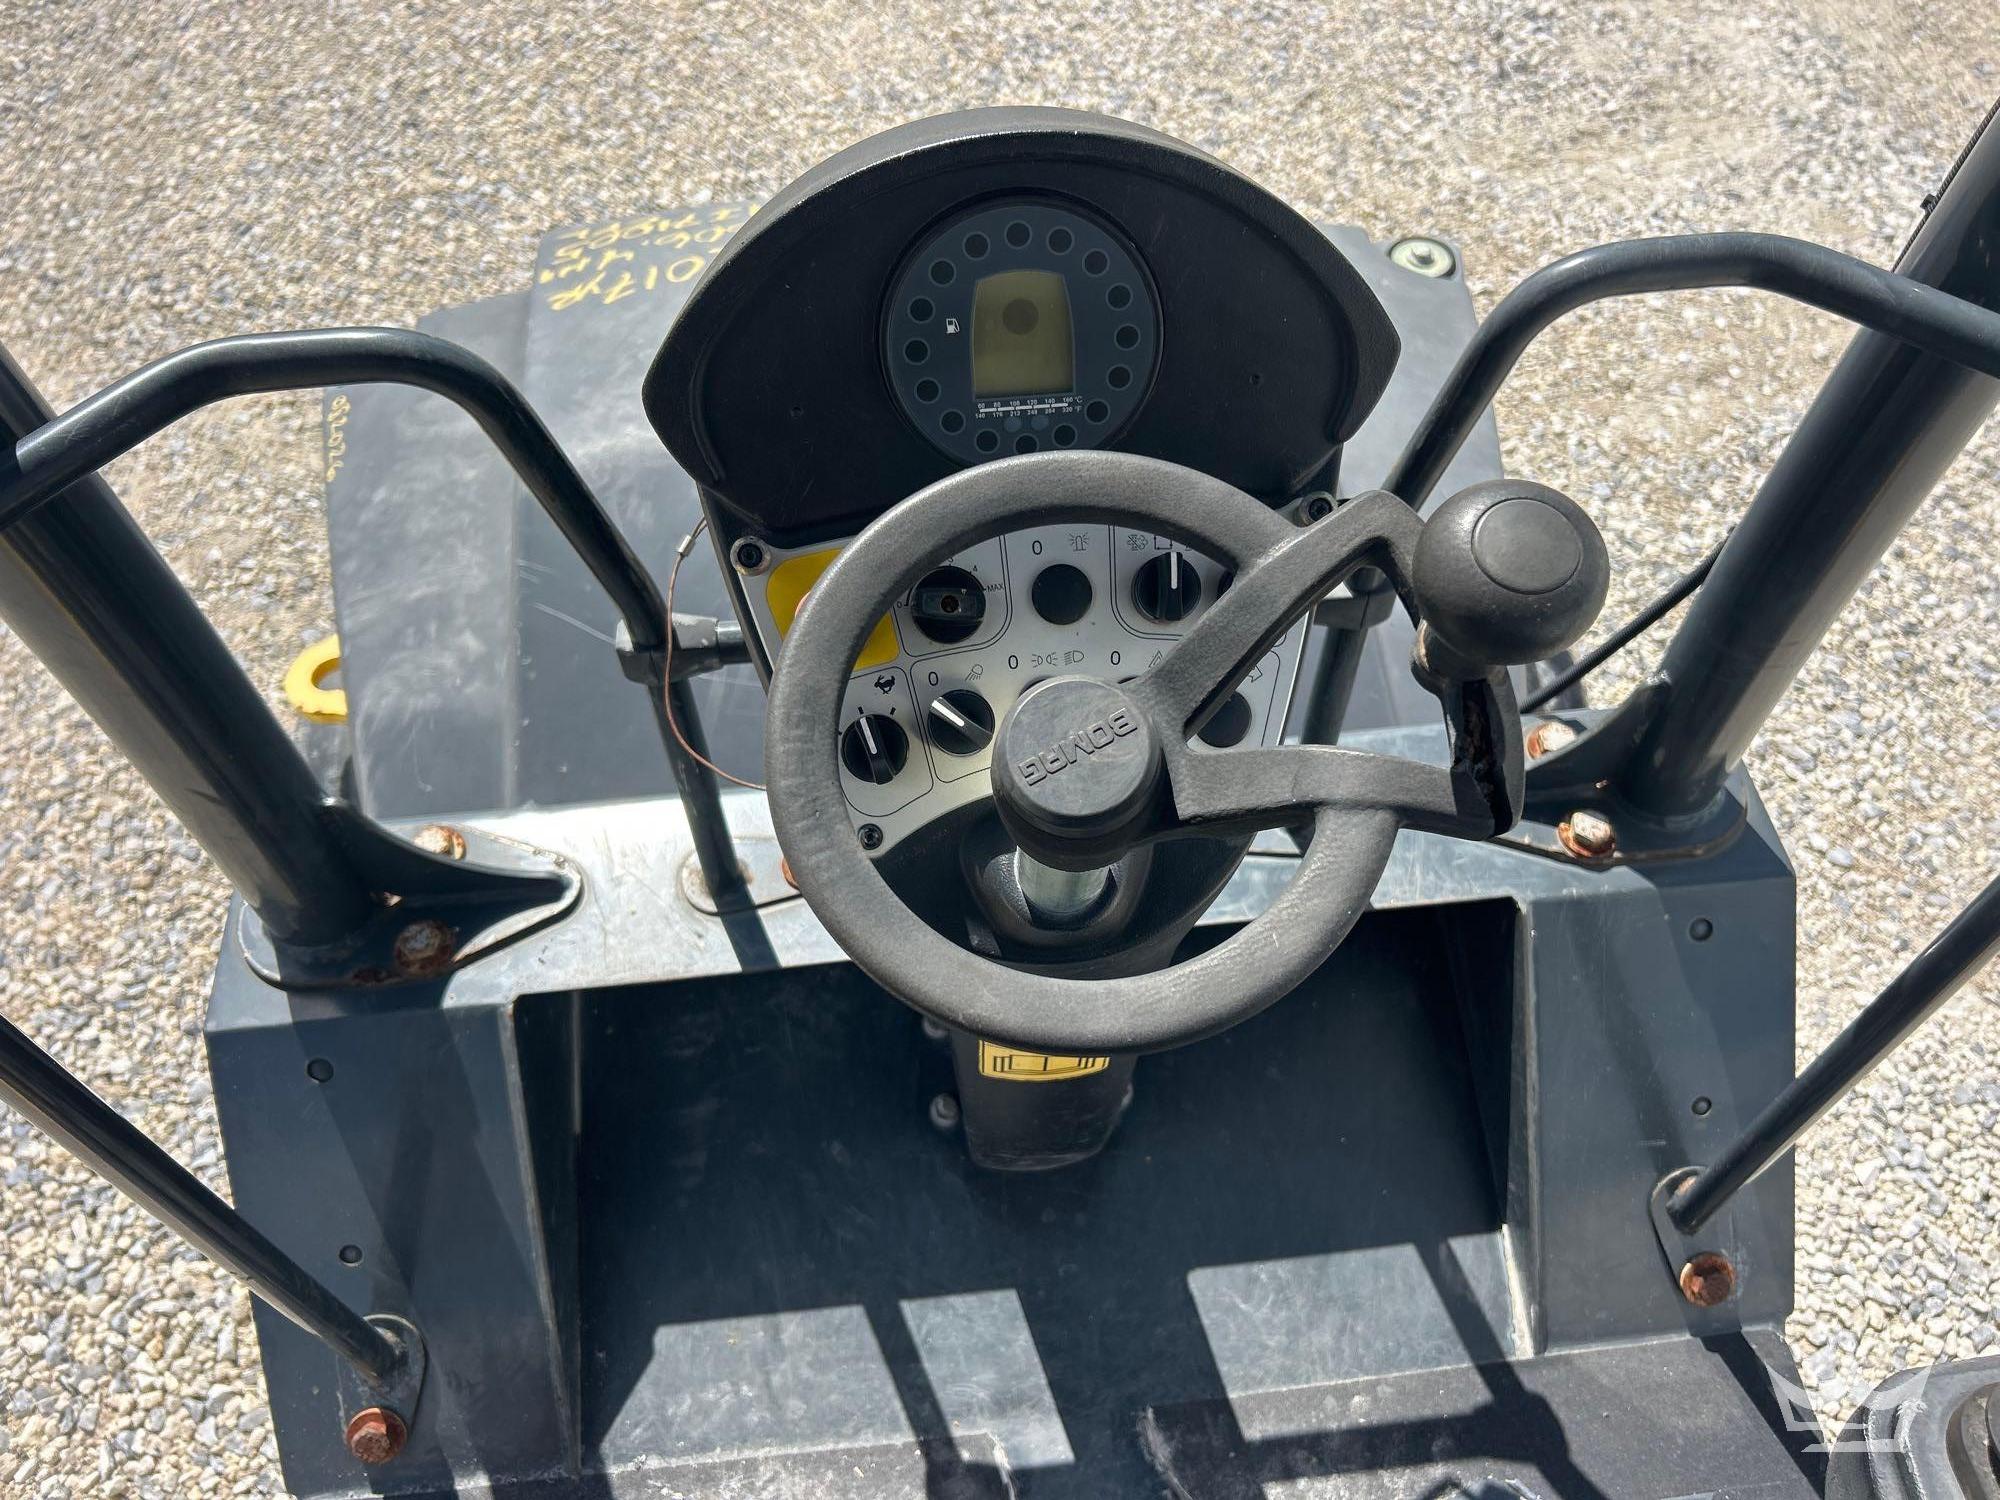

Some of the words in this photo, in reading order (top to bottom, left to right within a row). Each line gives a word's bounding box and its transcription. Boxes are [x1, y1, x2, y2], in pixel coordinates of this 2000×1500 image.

[1032, 540, 1043, 555] 0
[987, 583, 1005, 593] MAX
[1008, 655, 1019, 670] 0
[1110, 651, 1121, 665] 0
[928, 671, 939, 686] 0
[1018, 707, 1138, 786] BOMAG
